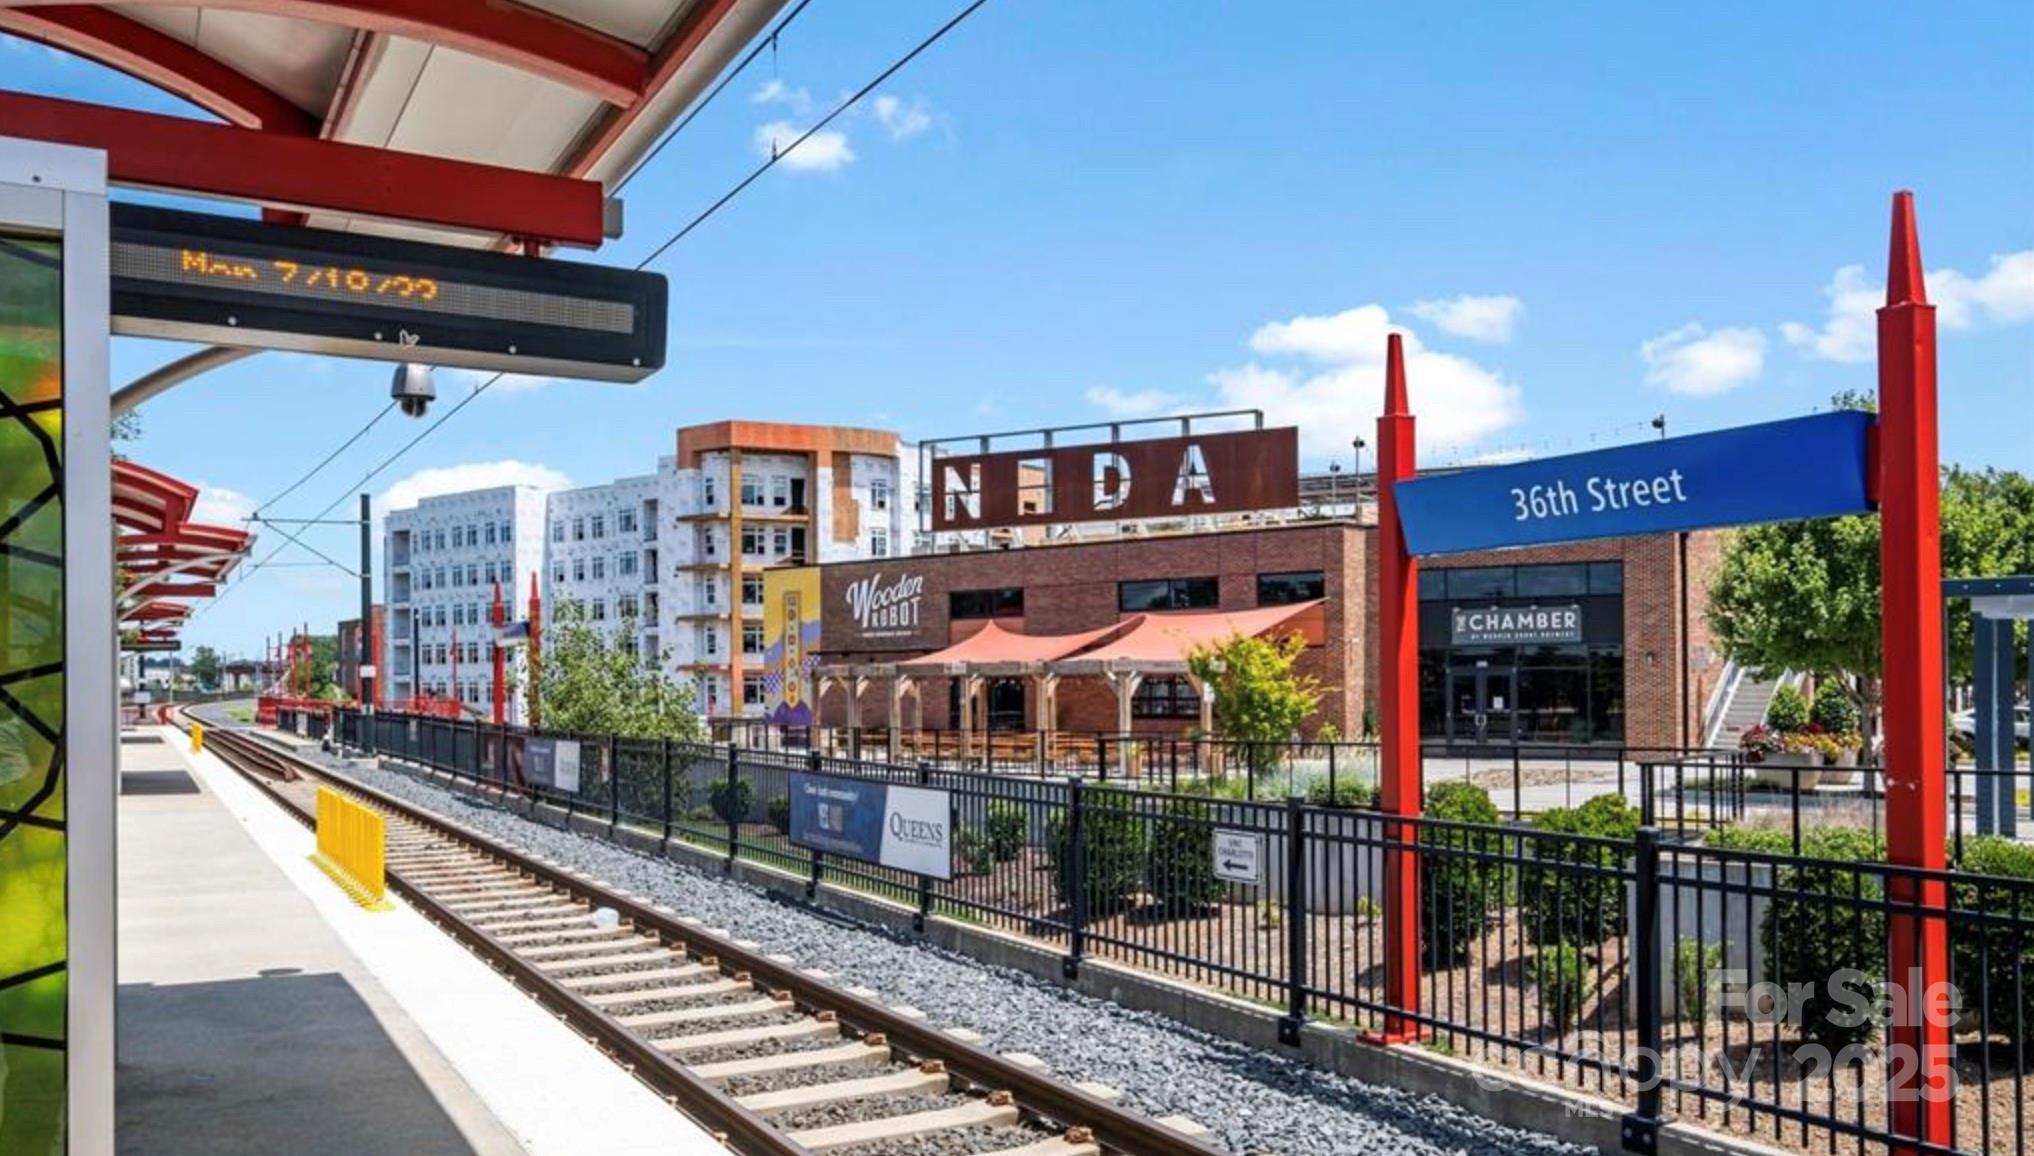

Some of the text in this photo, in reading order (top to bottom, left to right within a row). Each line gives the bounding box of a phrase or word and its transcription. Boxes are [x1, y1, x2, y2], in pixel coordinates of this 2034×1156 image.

[1510, 468, 1687, 521] 36th Street
[845, 572, 923, 628] Wooden
[871, 596, 921, 628] ROBOT
[1469, 611, 1577, 631] CHAMBER
